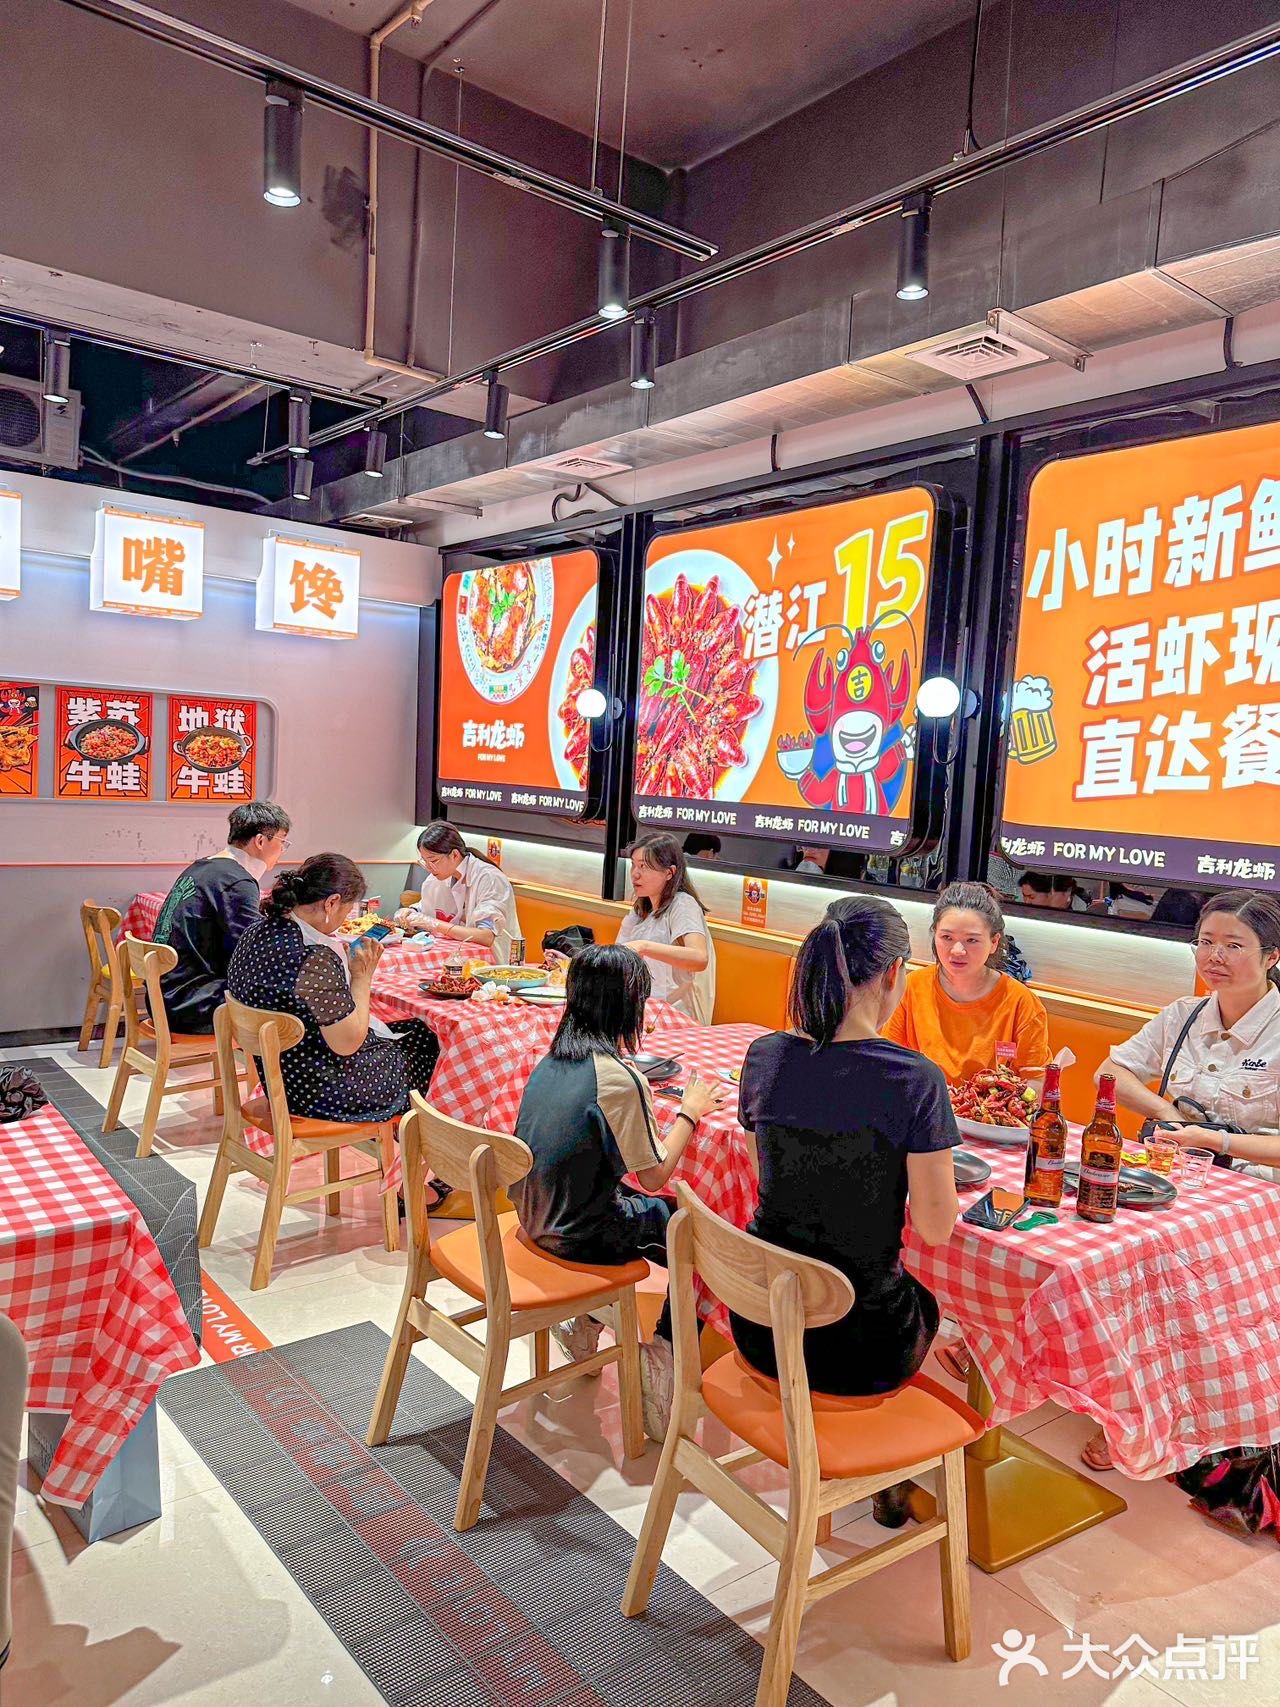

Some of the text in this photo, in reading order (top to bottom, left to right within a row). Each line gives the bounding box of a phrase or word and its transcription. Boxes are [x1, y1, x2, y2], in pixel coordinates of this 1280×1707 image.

[122, 536, 186, 596] 嘴
[289, 559, 344, 620] 馋
[743, 511, 929, 660] 潜江 15
[1086, 598, 1280, 706] 活虾现
[850, 670, 873, 698] 吉
[66, 697, 141, 727] 紫苏
[177, 705, 247, 735] 地狱
[1075, 701, 1280, 799] 直达餐
[66, 760, 141, 792] 牛蛙
[177, 766, 246, 794] 牛蛙
[464, 788, 477, 799] FOR
[476, 789, 486, 800] MY
[486, 790, 502, 801] LOVE
[538, 795, 553, 808] FOR
[552, 797, 564, 809] MY
[564, 799, 585, 813] LOVE
[676, 807, 695, 821] FOR
[695, 809, 710, 823] MY
[711, 811, 737, 825] LOVE
[798, 819, 819, 833] FOR
[820, 821, 838, 835] MY
[840, 822, 870, 839] LOVE
[1053, 841, 1088, 860] FOR
[1089, 846, 1117, 863] MY
[1119, 848, 1166, 868] LOVE
[211, 1323, 249, 1345] MY
